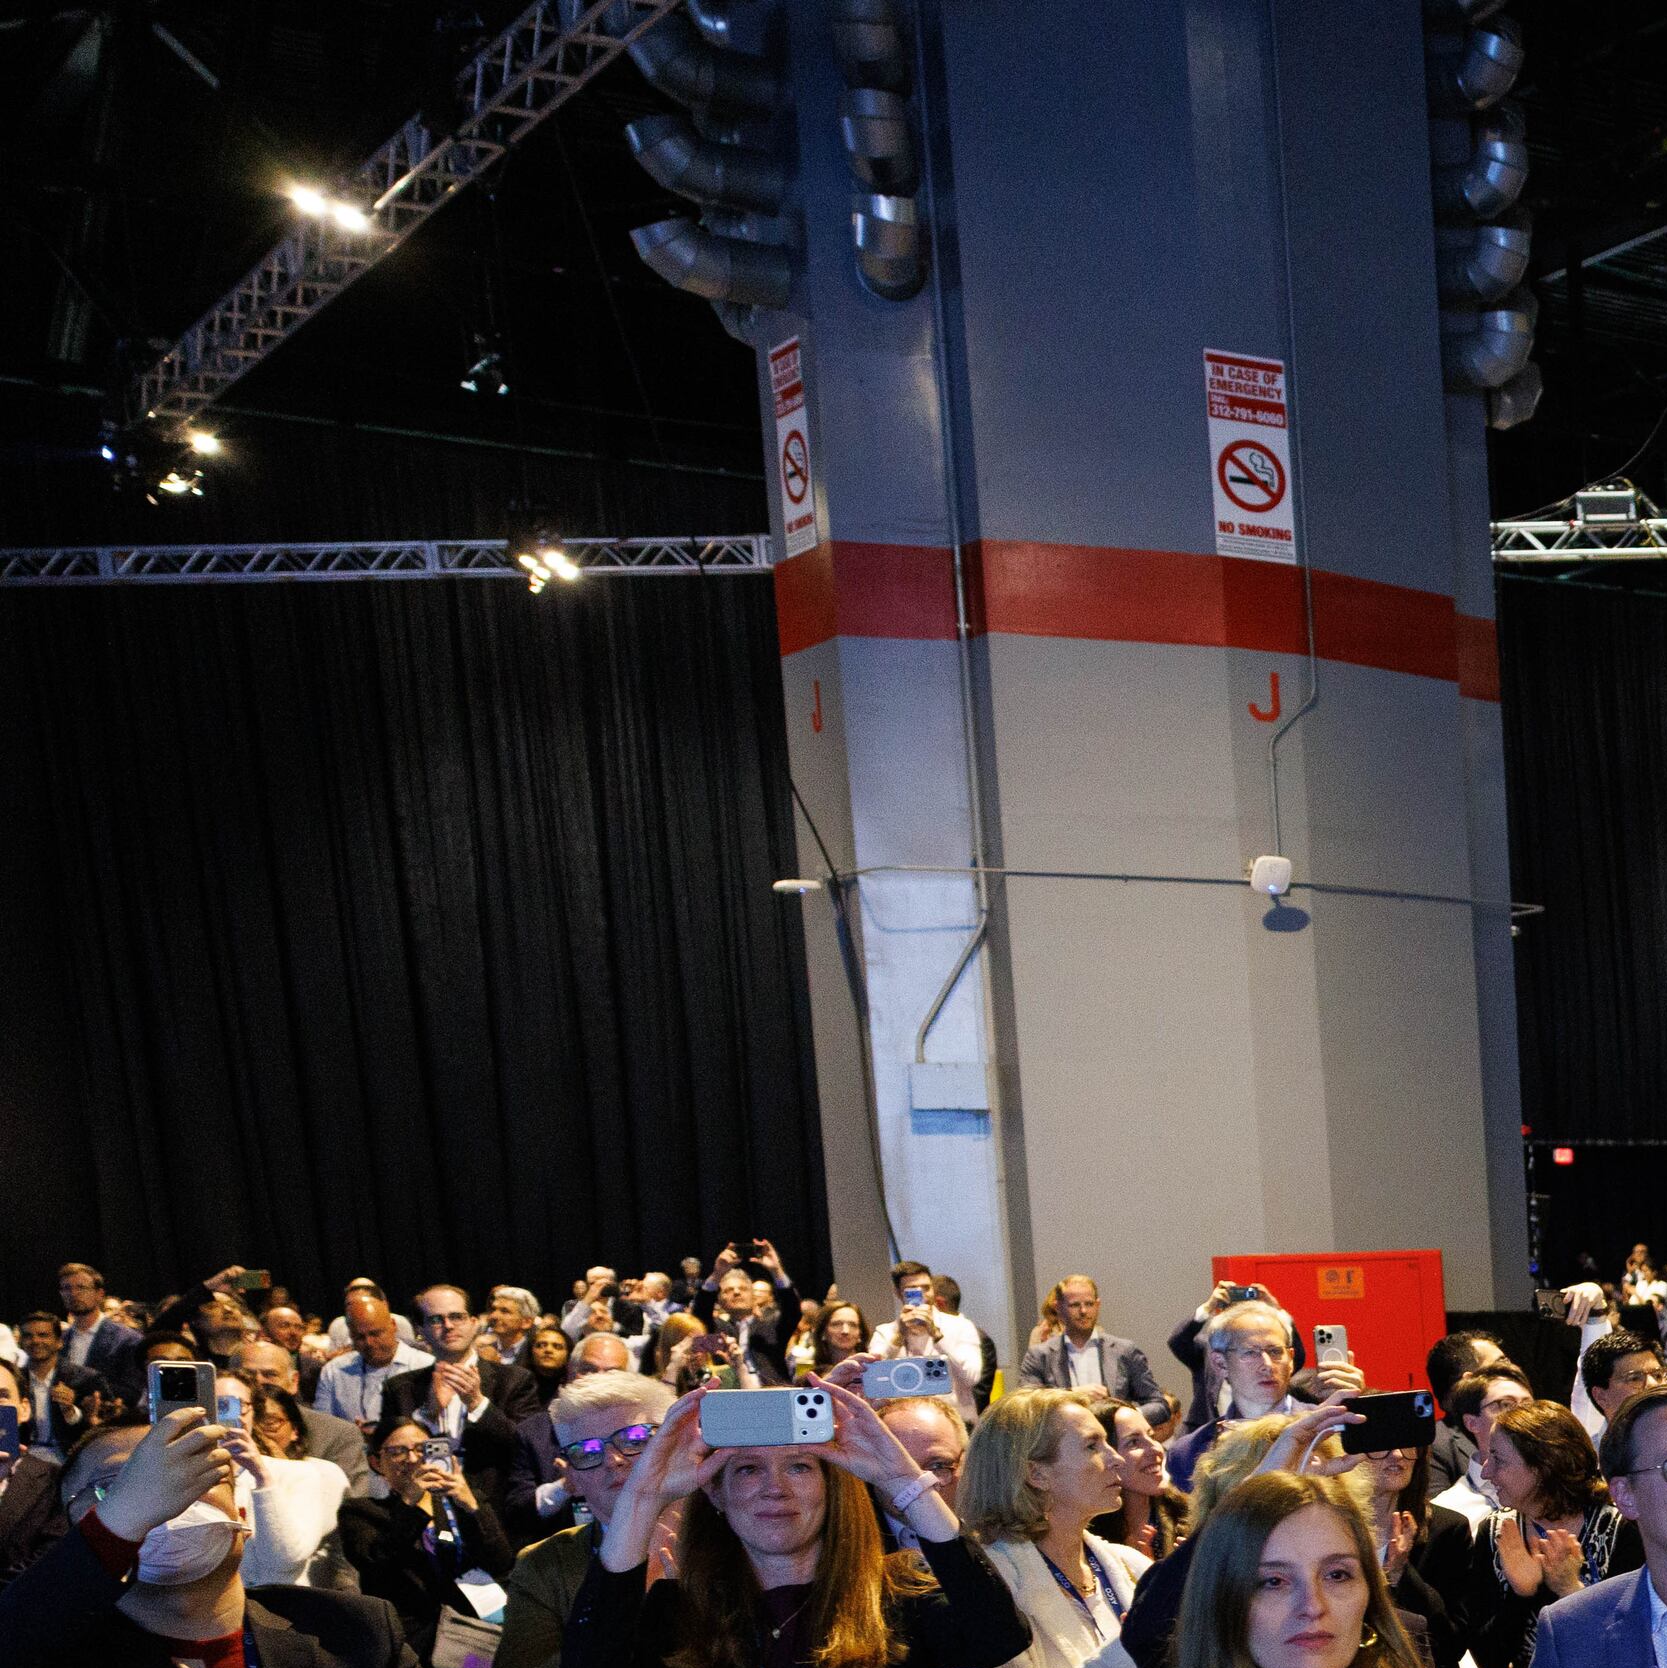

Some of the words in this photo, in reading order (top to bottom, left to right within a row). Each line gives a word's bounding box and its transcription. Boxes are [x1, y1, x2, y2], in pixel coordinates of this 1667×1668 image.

[1212, 364, 1224, 377] IN
[1228, 367, 1259, 382] CASE
[1263, 372, 1277, 385] OF
[1208, 377, 1281, 399] EMERGENCY
[1218, 521, 1235, 534] NO
[1238, 523, 1291, 541] SMOKING
[1247, 672, 1281, 723] J
[1088, 1556, 1102, 1572] ASCO
[1105, 1587, 1118, 1605] ASCO
